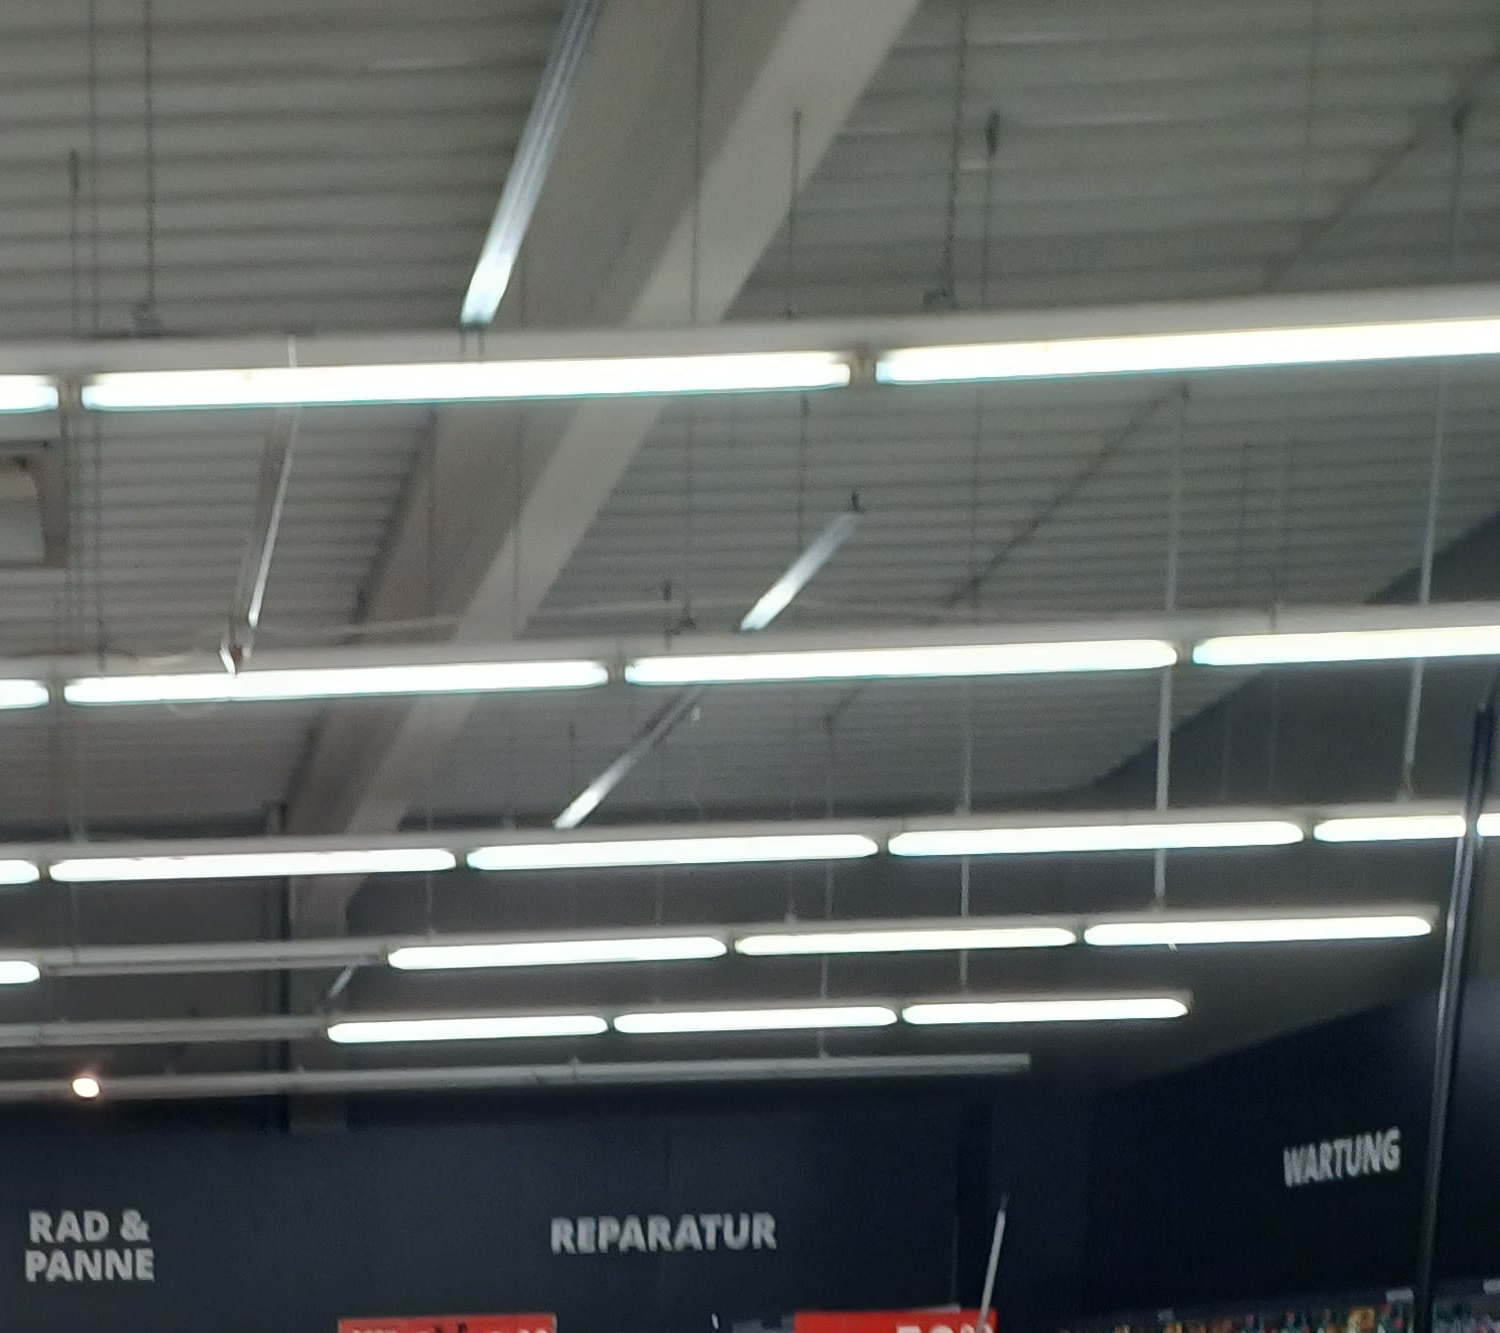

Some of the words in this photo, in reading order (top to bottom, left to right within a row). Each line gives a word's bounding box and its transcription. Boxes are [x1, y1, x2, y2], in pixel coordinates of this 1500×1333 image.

[1283, 1127, 1401, 1187] WARTUNG
[29, 1209, 110, 1243] RAD
[120, 1208, 150, 1242] &
[551, 1212, 777, 1255] REPARATUR
[25, 1248, 155, 1282] PANNE
